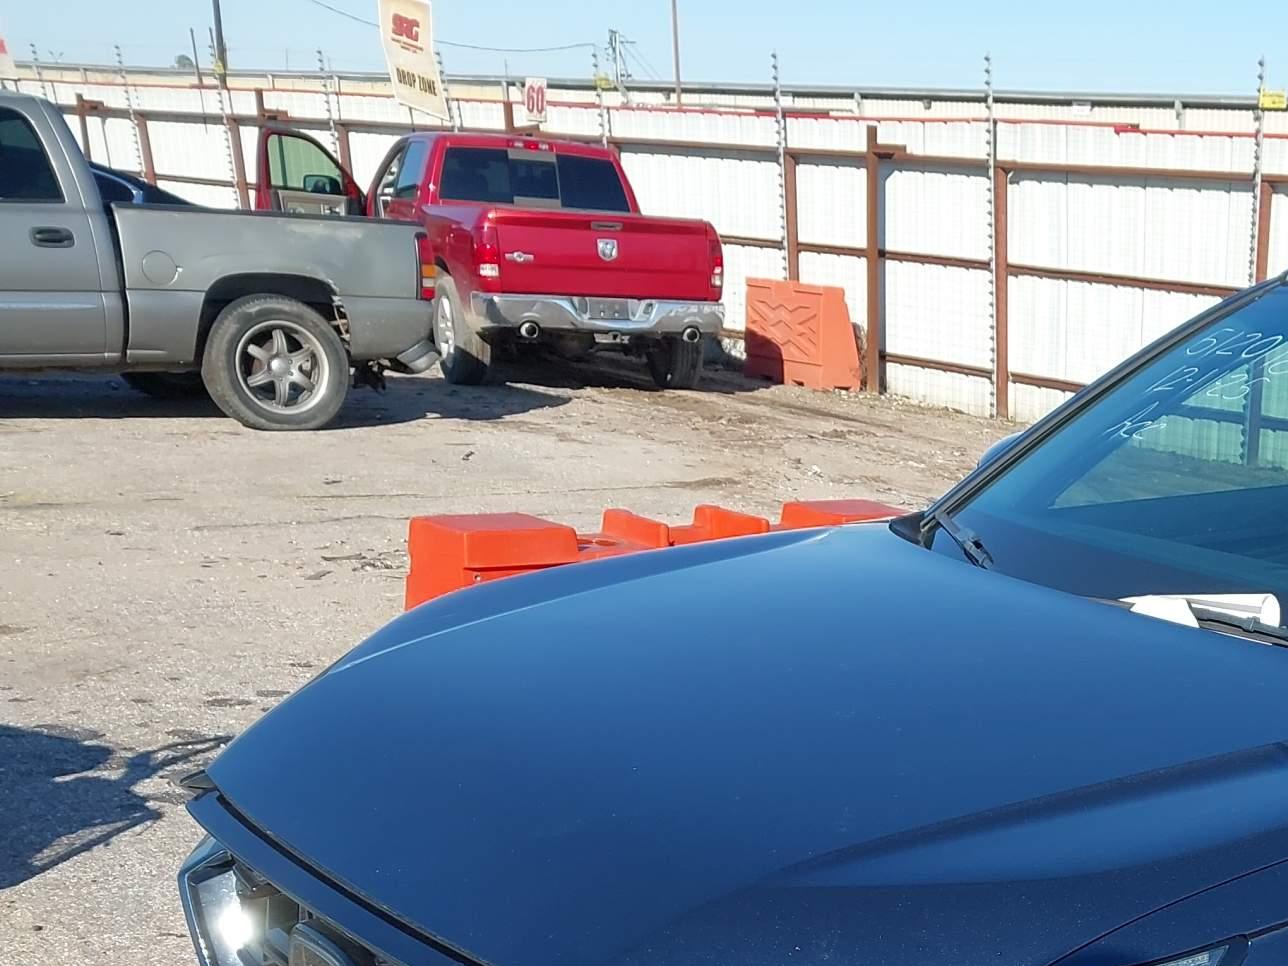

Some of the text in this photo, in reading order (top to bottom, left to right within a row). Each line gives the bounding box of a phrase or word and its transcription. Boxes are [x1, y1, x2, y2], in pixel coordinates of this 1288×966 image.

[395, 66, 438, 97] DROP ZONE
[526, 84, 545, 115] 60
